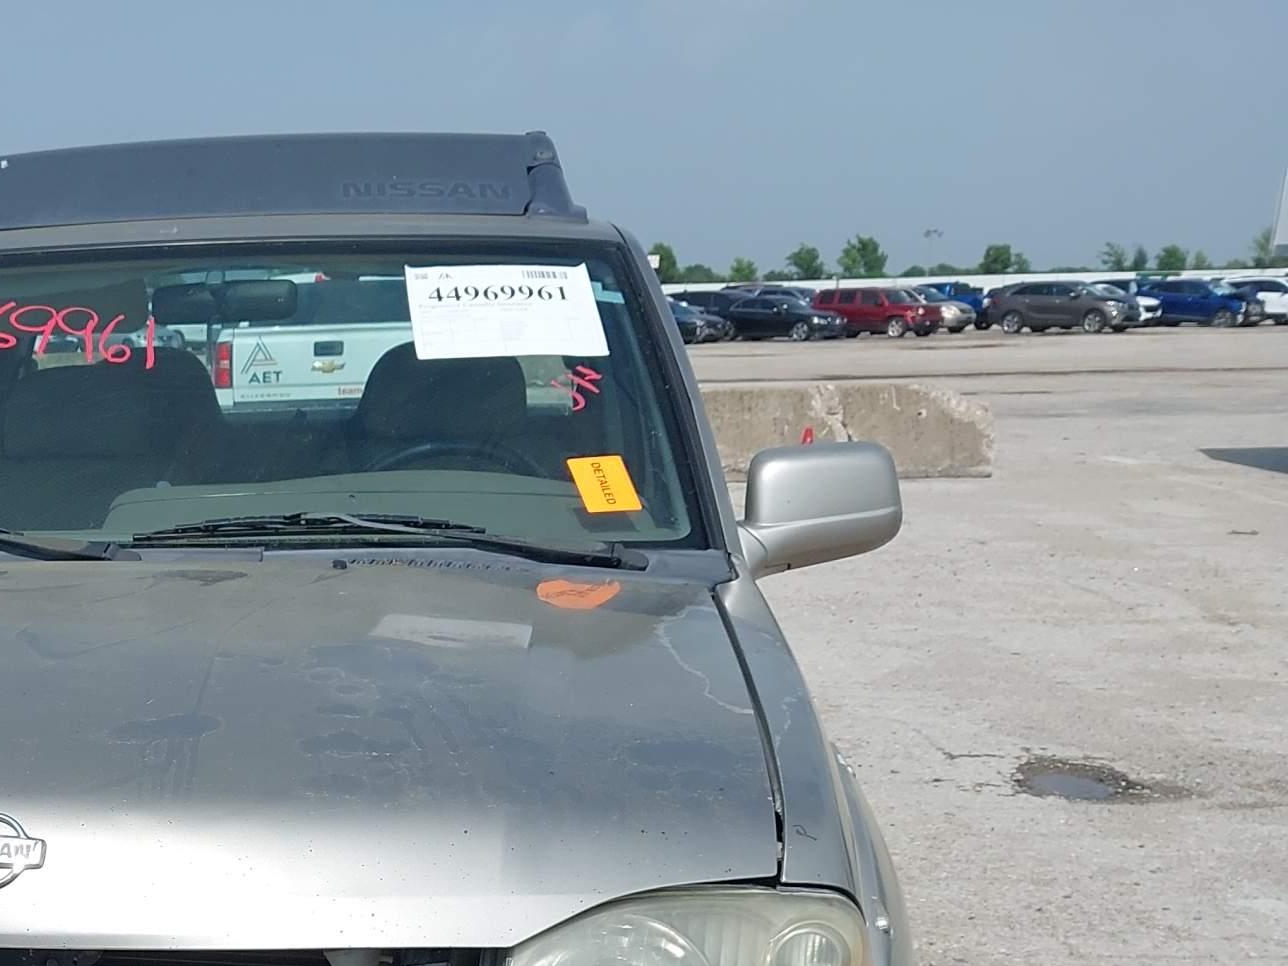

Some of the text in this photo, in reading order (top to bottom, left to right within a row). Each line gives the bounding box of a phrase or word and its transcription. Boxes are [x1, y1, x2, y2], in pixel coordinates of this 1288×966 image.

[341, 182, 512, 200] NISSAN
[428, 284, 569, 302] 44969961
[248, 371, 283, 384] AET
[590, 461, 617, 505] DETAILED
